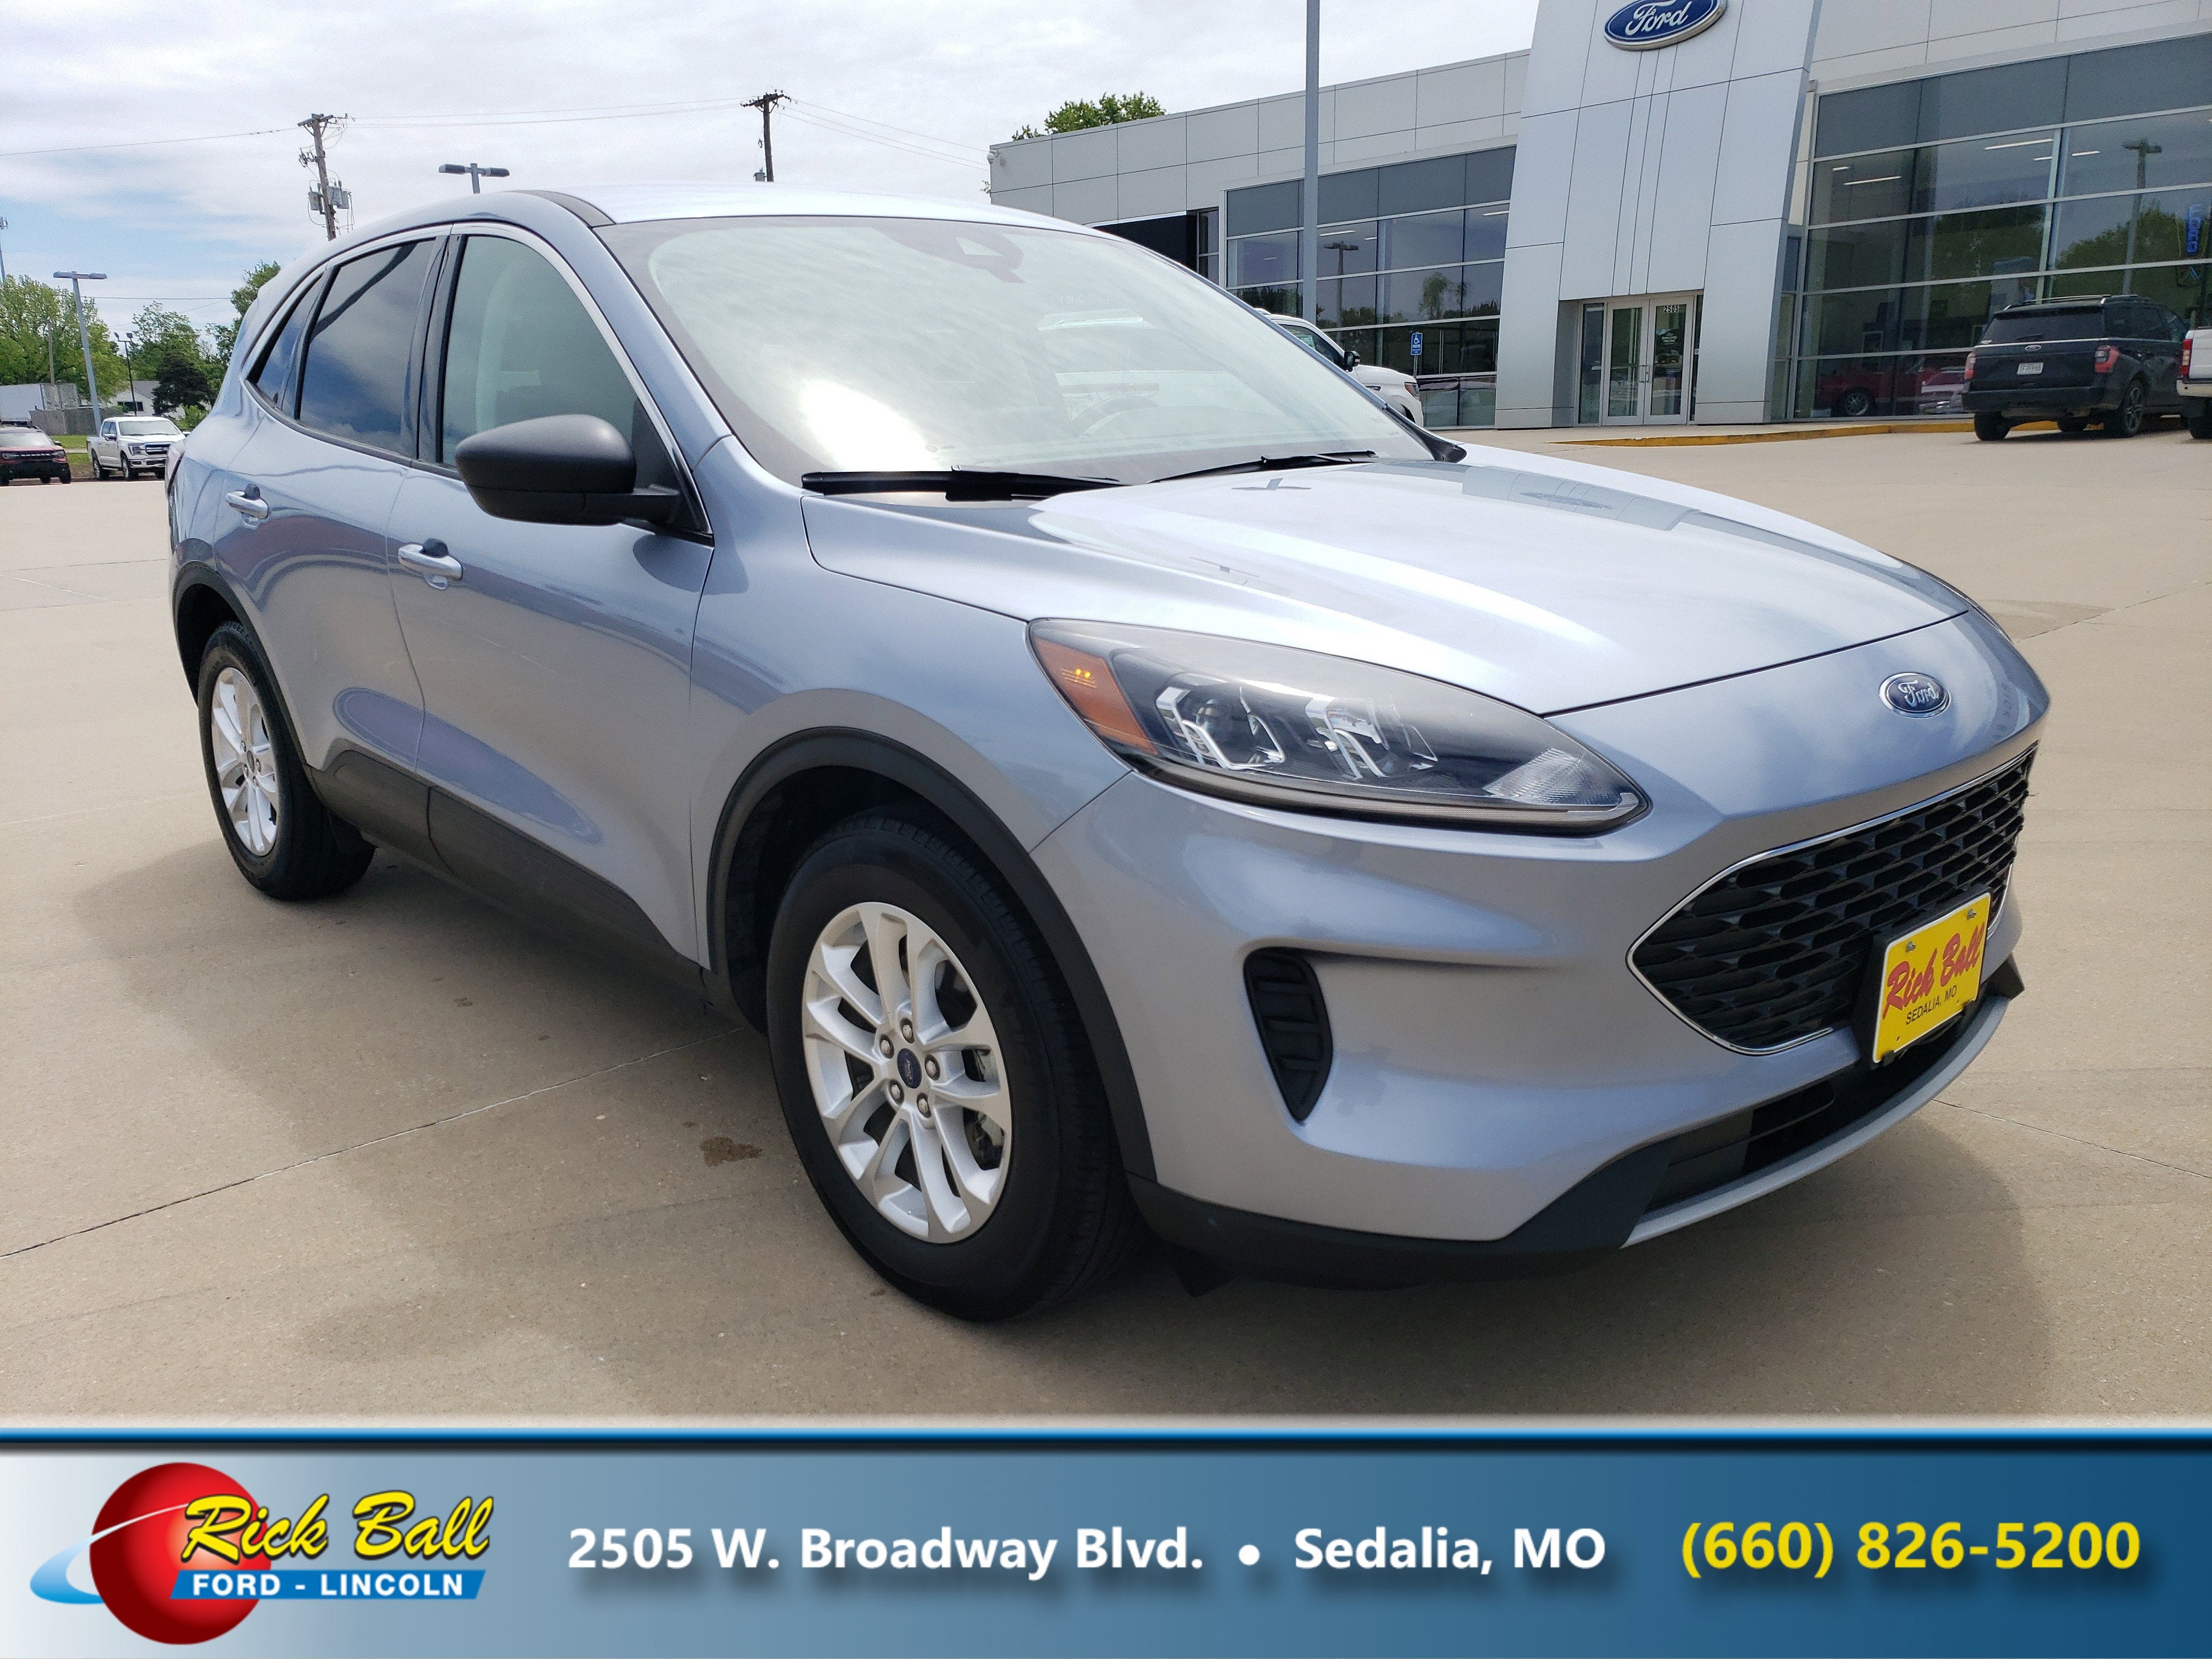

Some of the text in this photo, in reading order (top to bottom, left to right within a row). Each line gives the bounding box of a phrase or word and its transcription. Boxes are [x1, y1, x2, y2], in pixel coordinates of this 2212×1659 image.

[1627, 1, 1692, 35] Ford
[1898, 680, 1939, 707] Ford
[1883, 922, 1984, 1019] Rick Ball
[1906, 985, 1957, 1025] SEDALIA, MO
